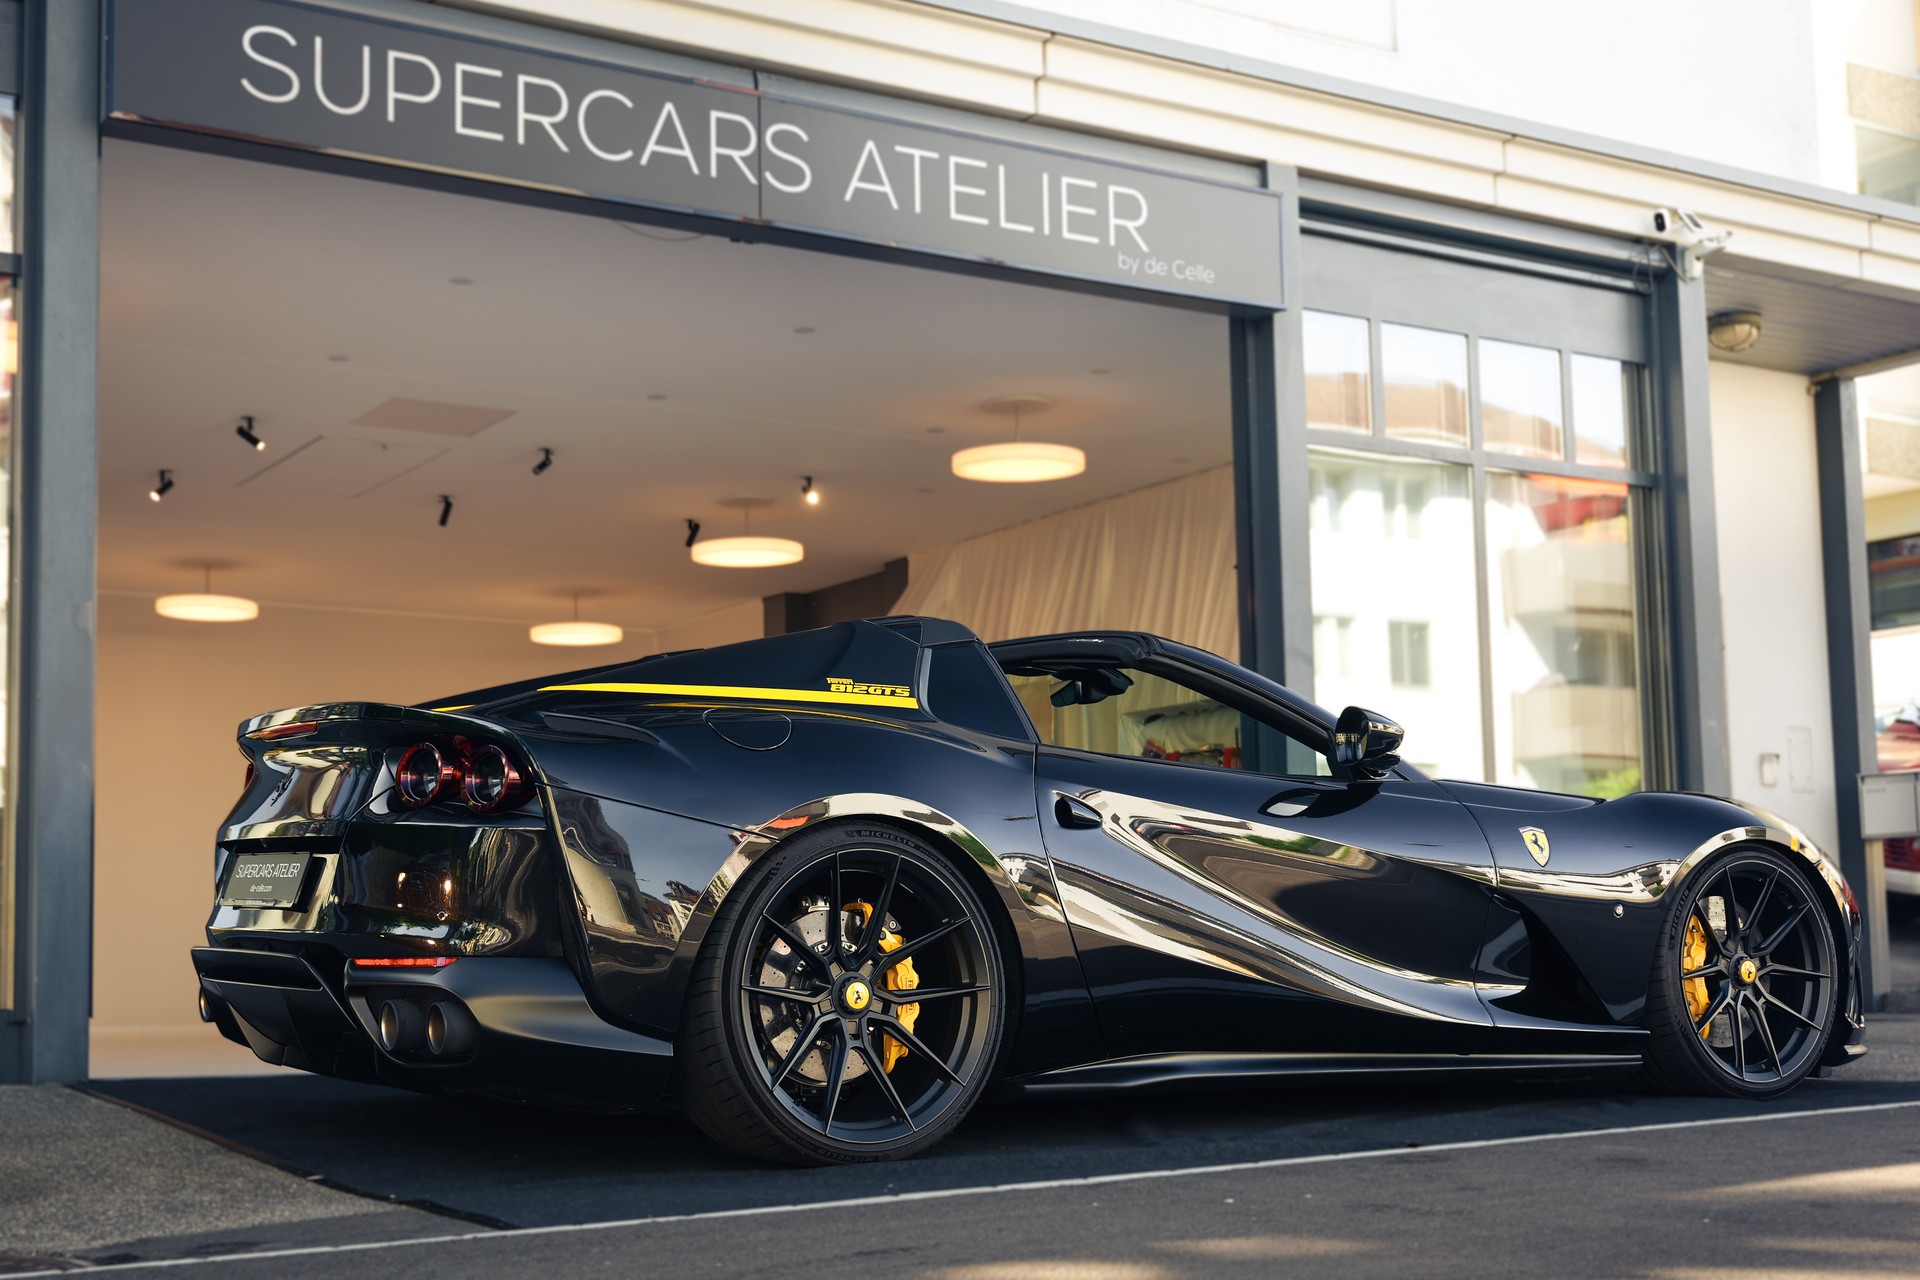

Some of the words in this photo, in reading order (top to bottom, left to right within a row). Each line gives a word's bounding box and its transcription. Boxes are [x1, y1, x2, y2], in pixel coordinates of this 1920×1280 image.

[240, 25, 812, 193] SUPERCARS
[844, 140, 1149, 252] ATELIER
[1118, 250, 1139, 275] by
[1144, 256, 1168, 276] de
[1172, 259, 1214, 284] Celle
[860, 830, 915, 847] MICHELIN
[236, 863, 275, 878] SUPERCARS
[272, 863, 301, 877] ATELIER
